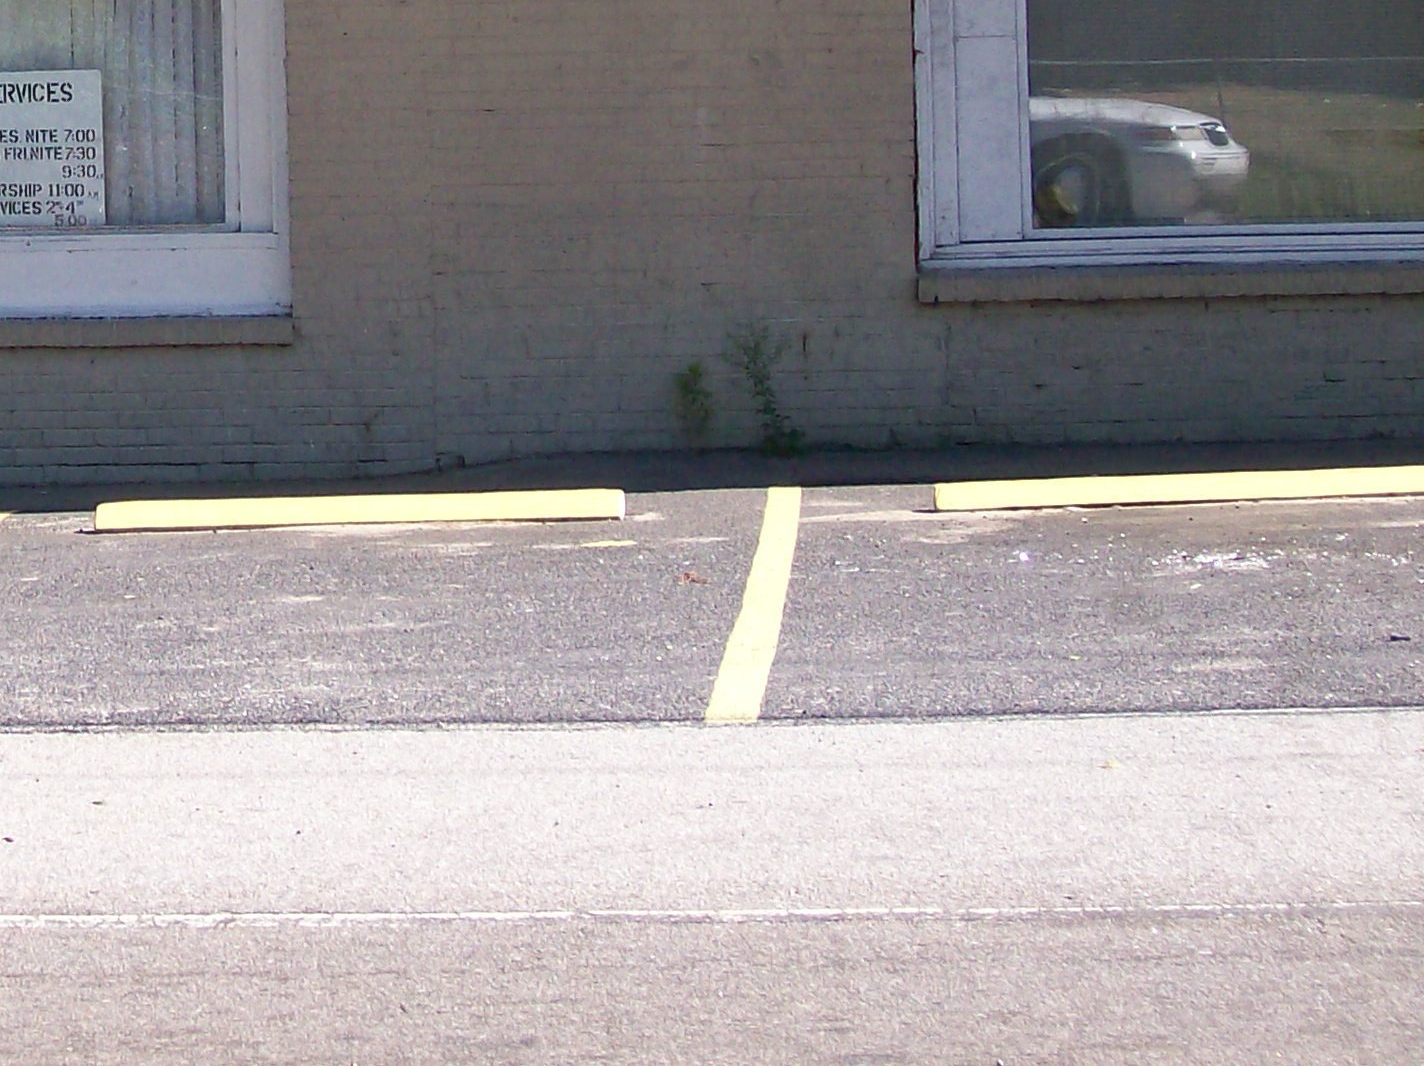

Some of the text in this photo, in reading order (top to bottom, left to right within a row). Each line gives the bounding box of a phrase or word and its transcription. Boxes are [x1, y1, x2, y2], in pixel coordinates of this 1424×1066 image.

[25, 129, 58, 143] NITE
[64, 129, 96, 143] 7:00
[62, 164, 97, 179] 9:30
[48, 183, 84, 197] 11:00
